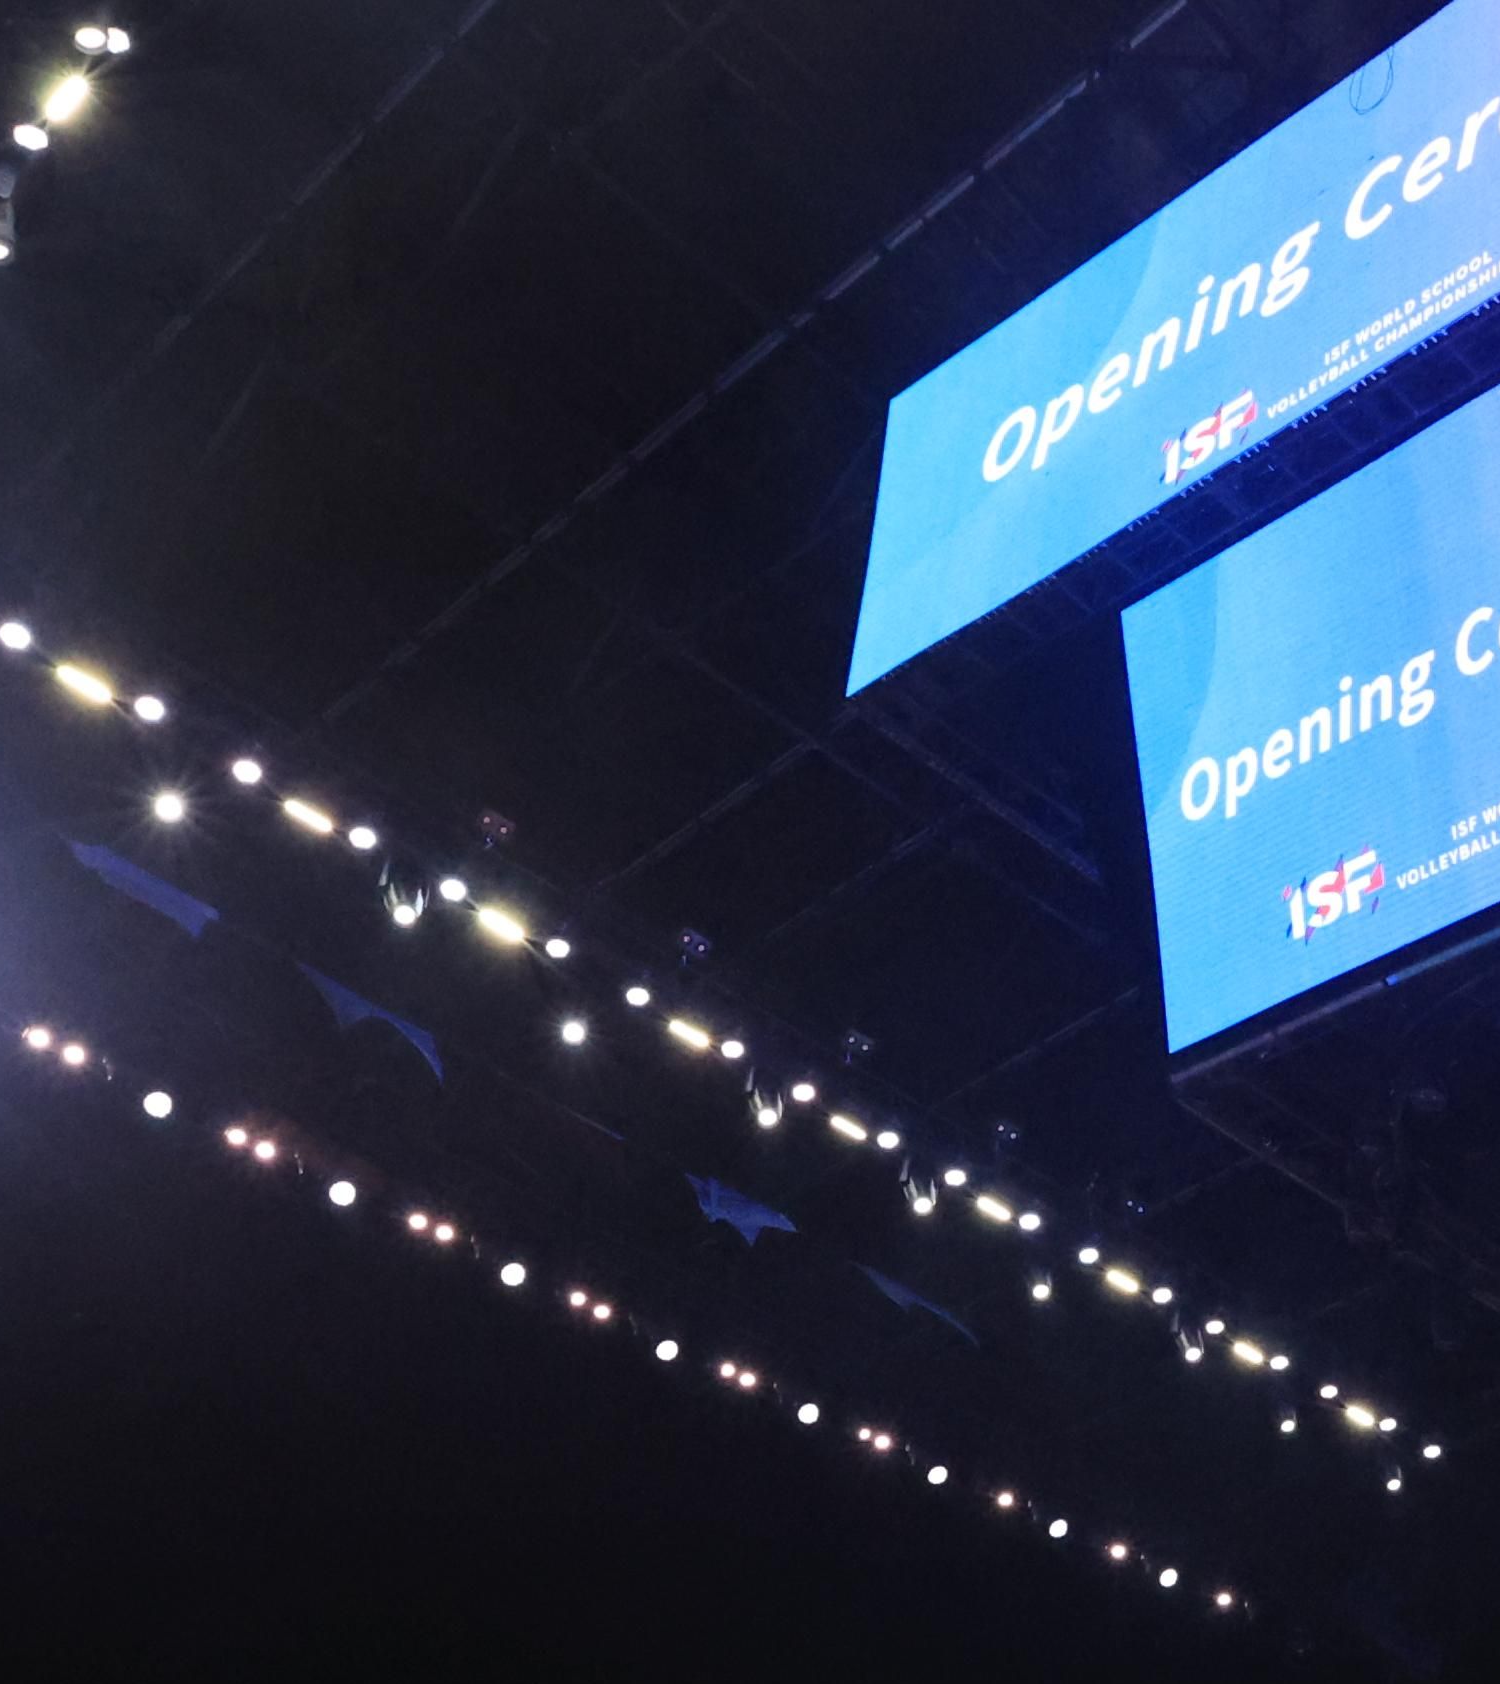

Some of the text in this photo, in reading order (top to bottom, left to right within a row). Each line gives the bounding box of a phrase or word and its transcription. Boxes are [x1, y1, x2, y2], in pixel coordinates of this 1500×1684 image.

[982, 222, 1320, 482] Opening
[1324, 251, 1492, 366] ISF WORLD SCHOOL
[1267, 349, 1369, 418] VOLLEYBALL
[1164, 391, 1253, 484] ISF
[1181, 650, 1434, 821] Opening
[1396, 832, 1500, 890] VOLLEYBALL
[1450, 818, 1478, 841] ISF
[1289, 849, 1377, 940] ISF
